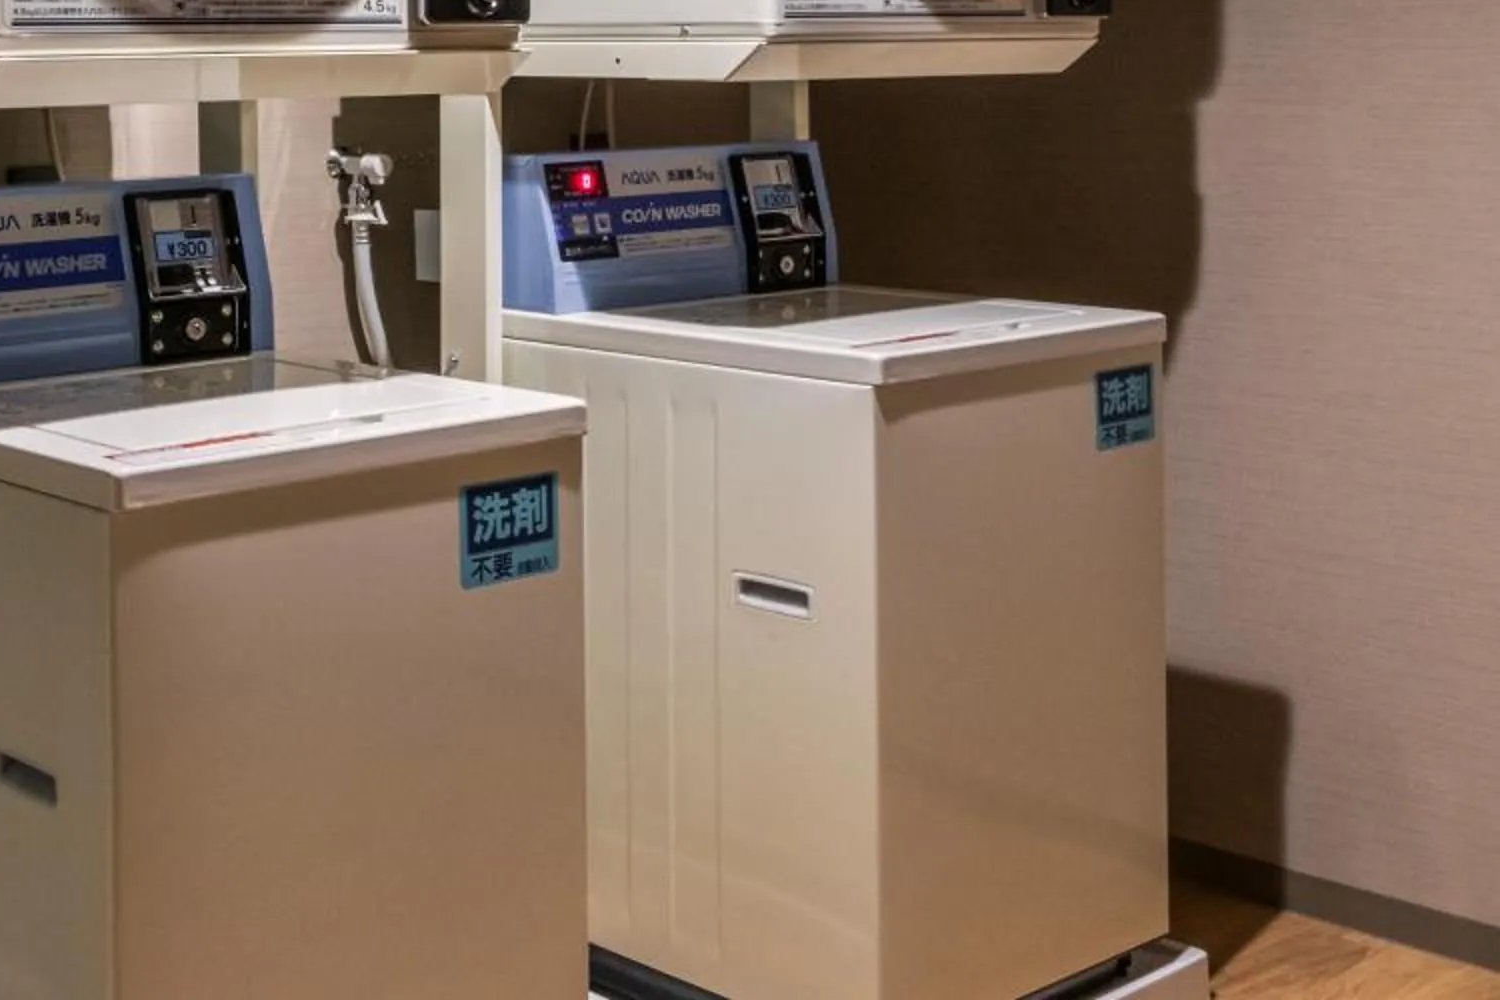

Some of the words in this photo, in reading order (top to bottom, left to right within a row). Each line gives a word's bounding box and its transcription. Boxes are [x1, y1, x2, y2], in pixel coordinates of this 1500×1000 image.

[75, 207, 102, 226] 5kg
[666, 202, 722, 221] WASHER
[25, 253, 107, 276] WASHER
[1101, 371, 1148, 417] 洗剤
[474, 485, 547, 542] 洗剤
[470, 551, 513, 583] 不要
